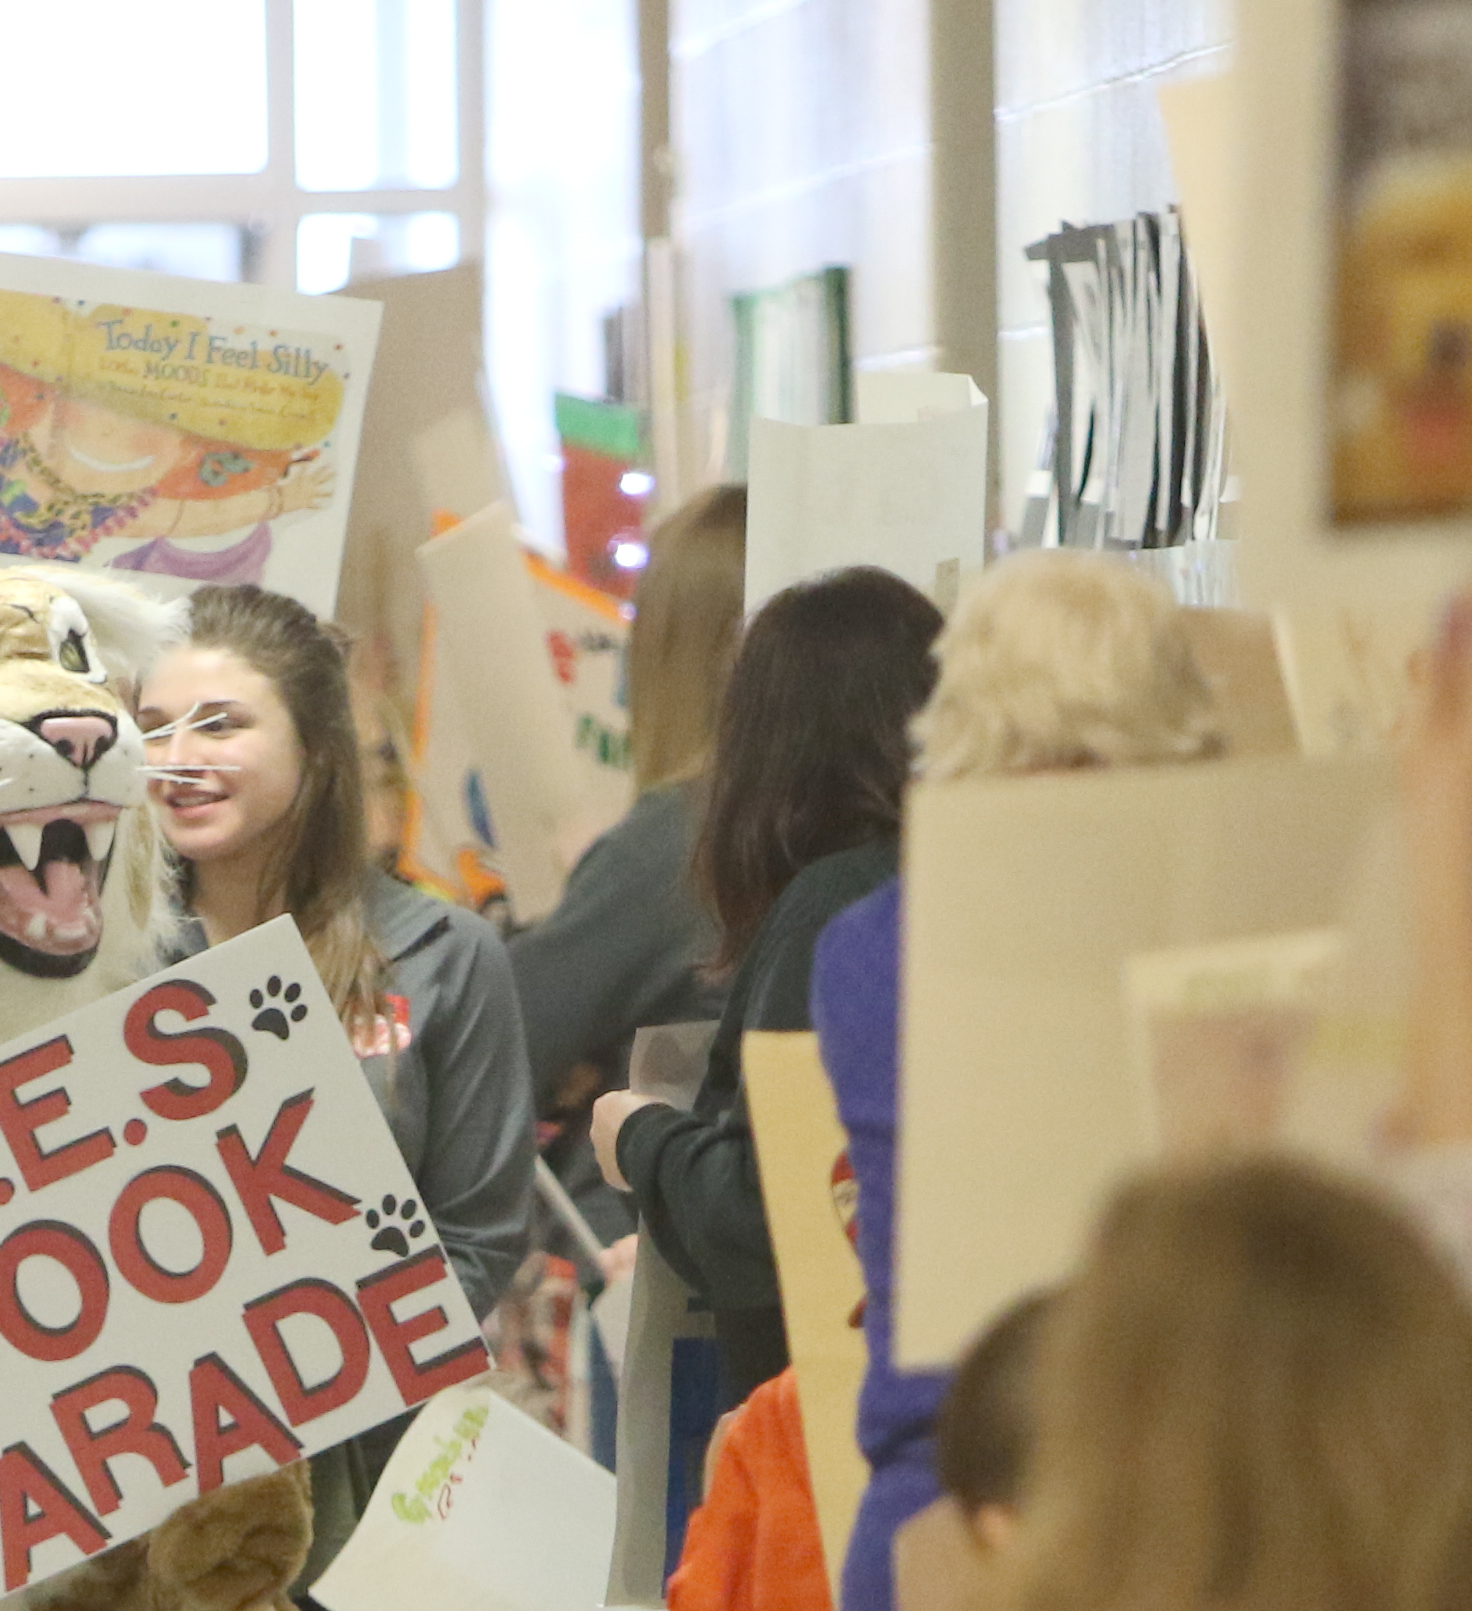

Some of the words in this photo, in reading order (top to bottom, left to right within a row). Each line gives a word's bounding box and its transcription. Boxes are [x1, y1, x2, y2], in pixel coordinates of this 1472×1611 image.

[96, 318, 181, 361] Today
[184, 331, 201, 361] I
[205, 335, 259, 370] Feel
[266, 344, 329, 386] Silly
